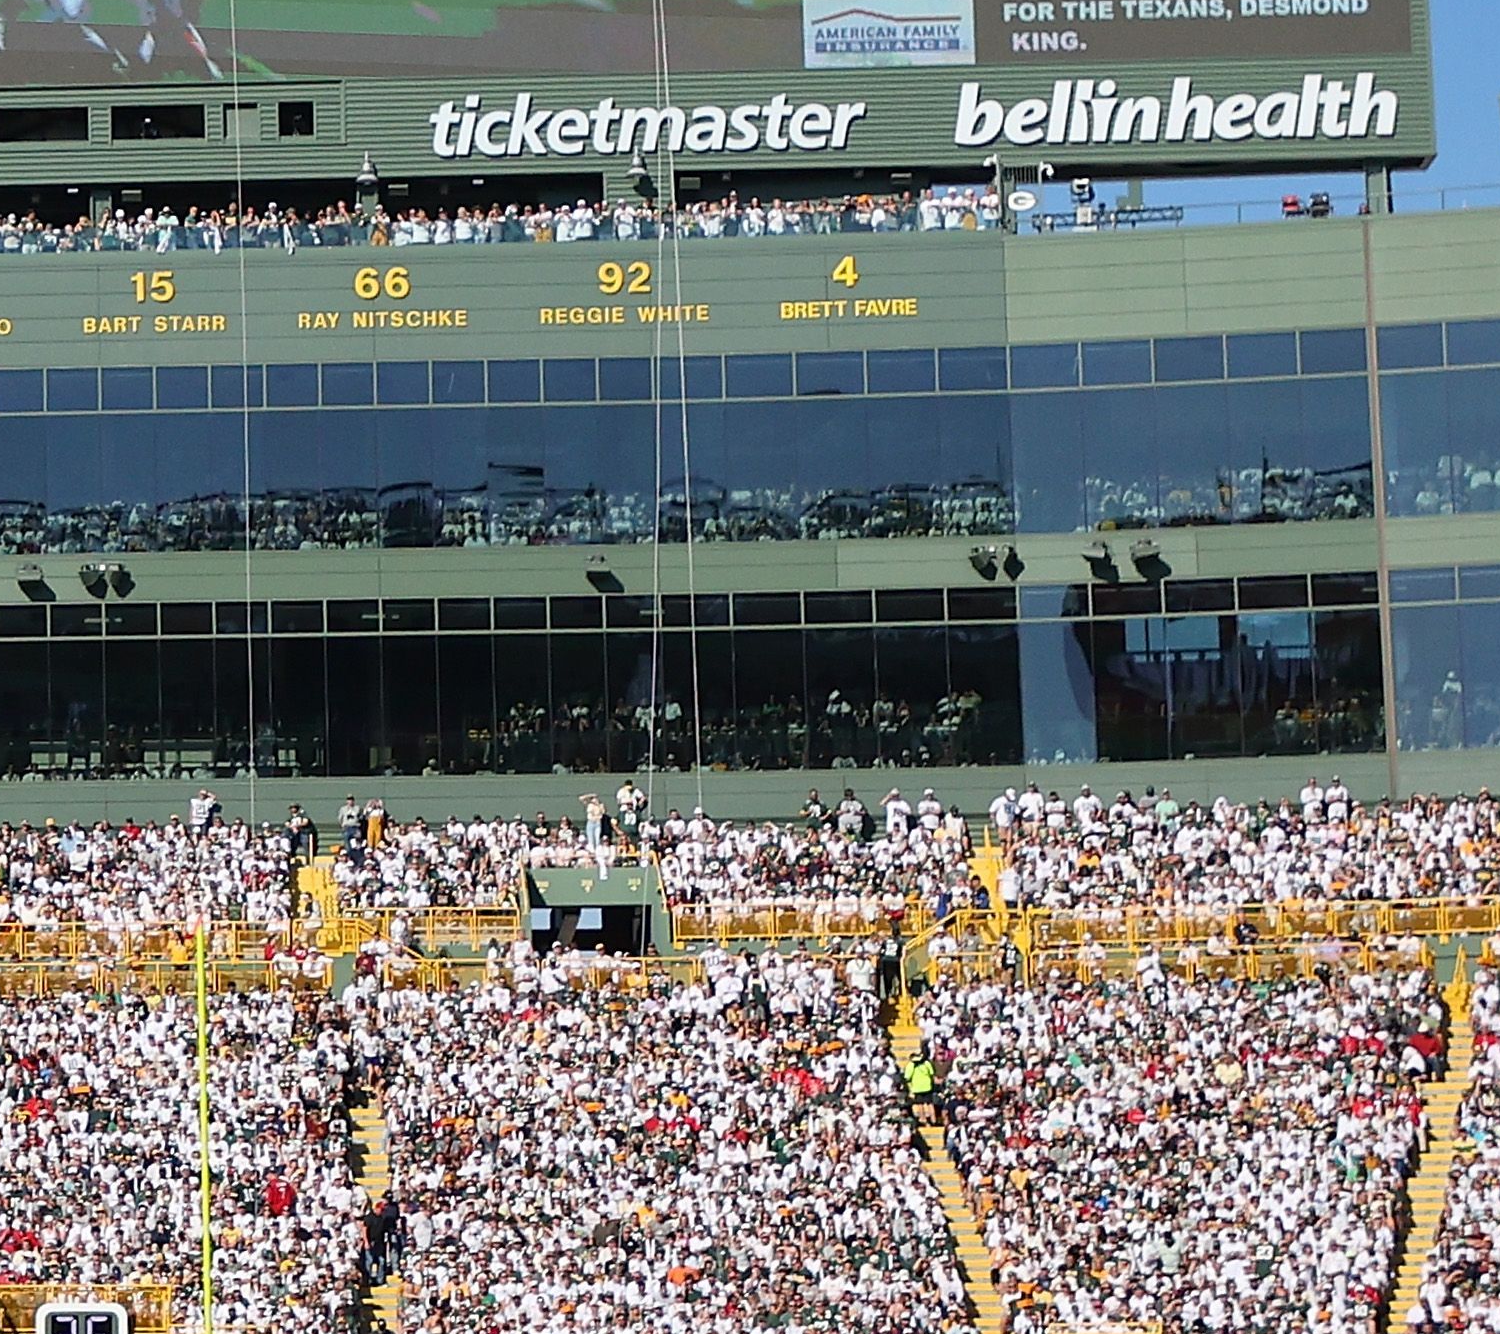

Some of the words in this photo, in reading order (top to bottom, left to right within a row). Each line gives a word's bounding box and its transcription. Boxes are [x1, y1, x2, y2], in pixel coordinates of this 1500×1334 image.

[1003, 0, 1055, 23] FOR
[1060, 0, 1115, 22] THE
[815, 24, 898, 43] AMERICAN
[903, 22, 960, 40] FAMILY
[1012, 30, 1087, 53] KING.
[429, 91, 868, 161] ticketmaster
[353, 266, 411, 300] 66
[597, 260, 653, 295] 92
[830, 254, 860, 289] 4
[129, 269, 176, 303] 15
[297, 311, 343, 330] RAY
[352, 308, 469, 328] NITSCHKE
[539, 305, 626, 325] REGGIE
[636, 302, 710, 322] WHITE
[780, 300, 846, 321] BRETT
[853, 296, 919, 318] FAVRE
[82, 314, 145, 334] BART
[154, 313, 226, 333] STARR
